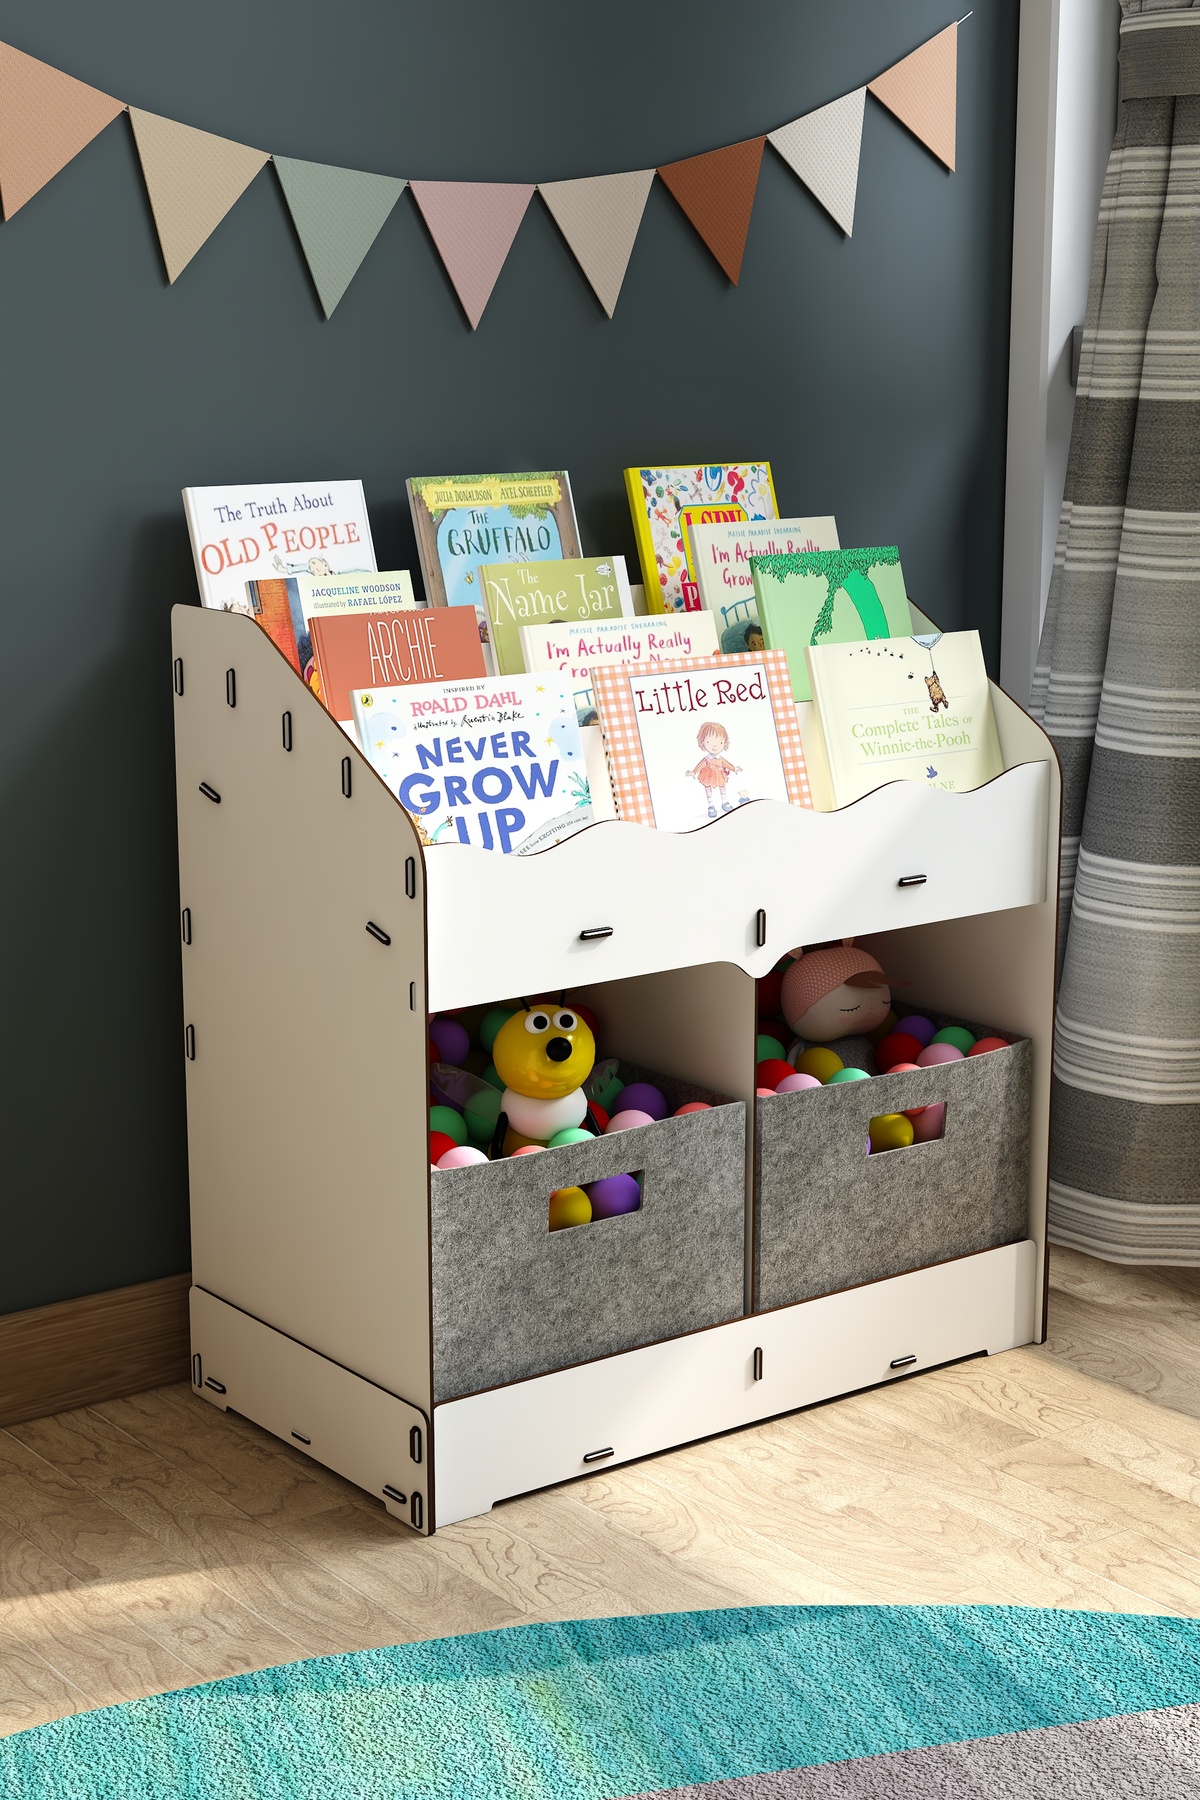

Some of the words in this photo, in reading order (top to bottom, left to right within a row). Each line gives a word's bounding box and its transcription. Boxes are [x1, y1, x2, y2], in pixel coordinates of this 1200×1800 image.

[435, 491, 454, 504] JULIA
[455, 489, 492, 502] DONALDSON
[500, 488, 518, 500] AXEL
[518, 485, 554, 499] SCHEFFLER
[214, 505, 243, 523] The
[245, 498, 288, 518] Truth
[292, 492, 334, 512] About
[468, 509, 489, 525] THE
[201, 537, 260, 575] OLD
[260, 522, 360, 553] PEOPLE
[447, 525, 551, 556] GRUFFALO
[711, 543, 730, 564] I'm
[517, 568, 539, 585] The
[311, 586, 360, 597] JACQUELINE
[361, 583, 401, 593] WOODSON
[313, 600, 339, 609] illustrated
[340, 600, 347, 609] by
[347, 597, 377, 607] RAFAEL
[378, 595, 403, 605] LÓPEZ
[486, 577, 569, 625] Name
[574, 573, 615, 619] Jar
[569, 627, 593, 635] MAISIE
[596, 624, 627, 633] PARADISE
[630, 621, 668, 630] SHEARRING
[367, 617, 444, 684] ARCHIE
[546, 641, 570, 660] I'm
[577, 634, 641, 660] Actually
[647, 631, 692, 655] Really
[443, 686, 475, 694] INSPIRED
[635, 679, 708, 715] Little
[712, 672, 766, 705] Red
[410, 697, 468, 717] ROALD
[474, 691, 522, 710] DAHL
[901, 707, 920, 715] THE
[460, 713, 496, 728] Quentin
[496, 710, 524, 724] Blake
[851, 720, 919, 739] Complete
[922, 714, 959, 730] Tales
[962, 716, 973, 724] OF
[415, 730, 537, 770] NEVER
[860, 731, 971, 757] Winnie-the-Pooh
[399, 759, 560, 816] GROW
[455, 807, 526, 855] UP
